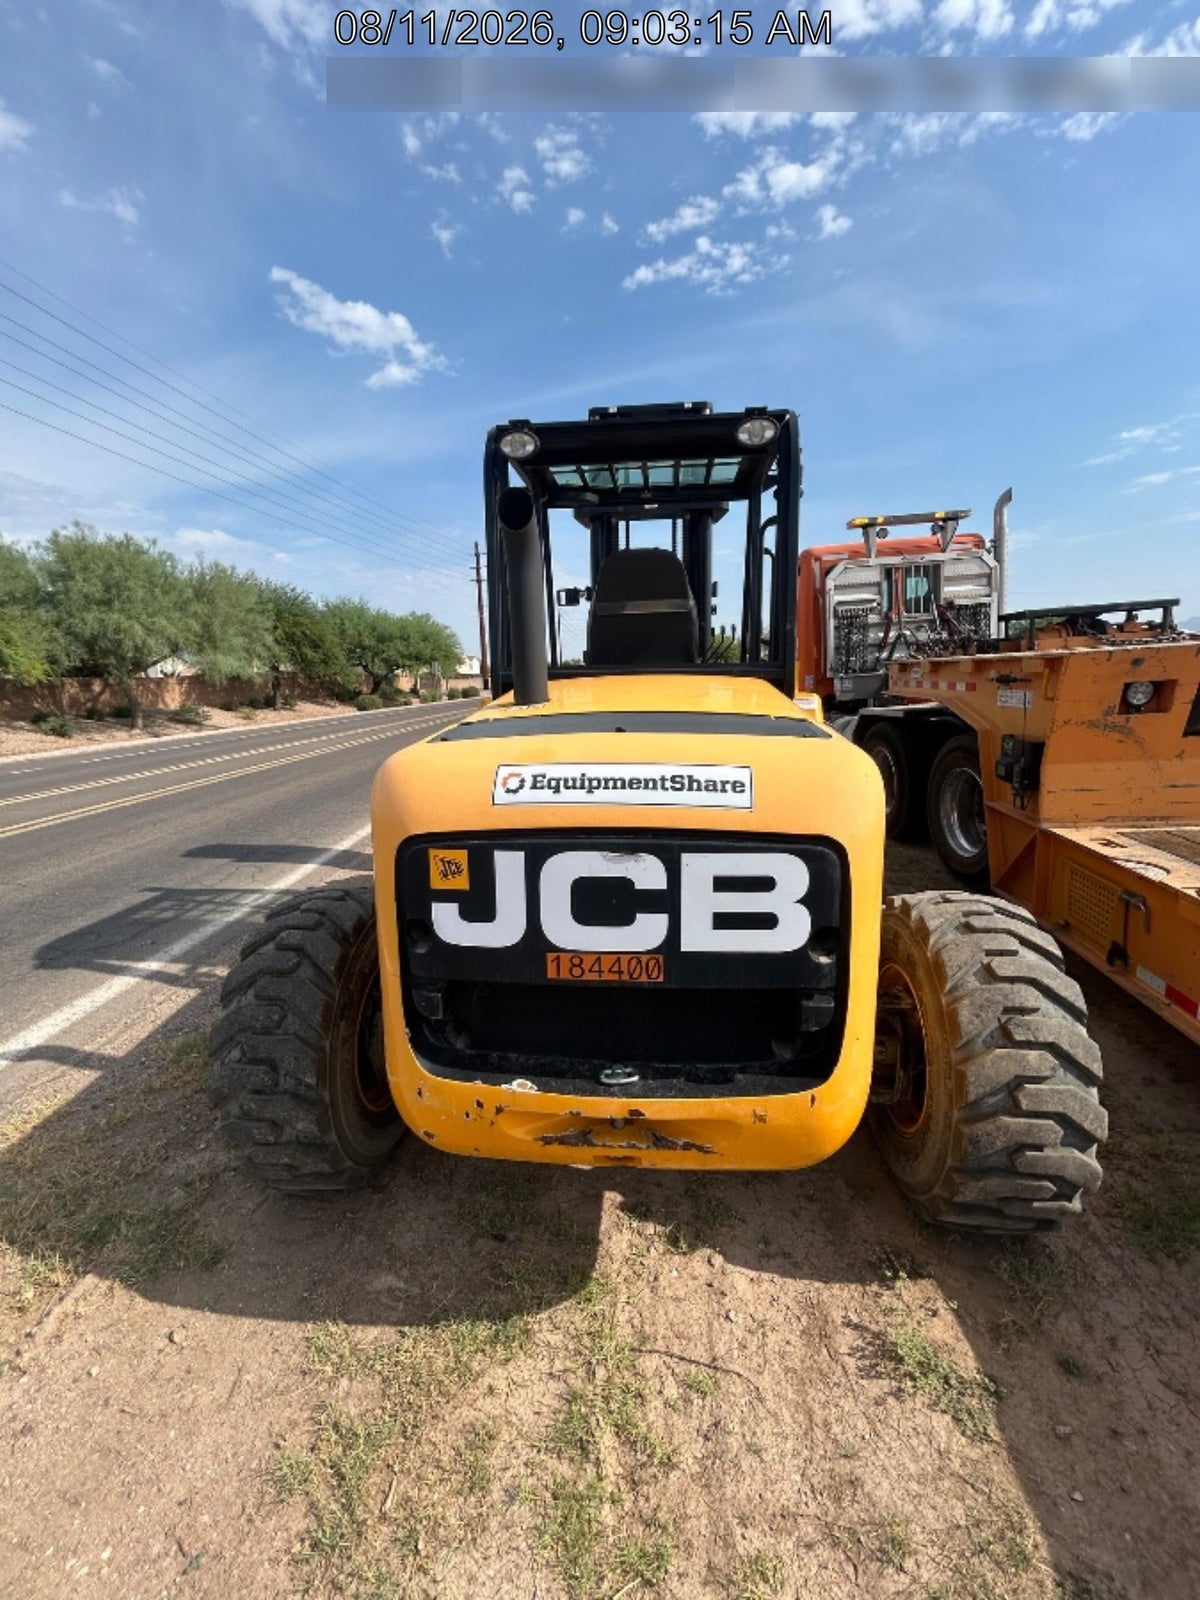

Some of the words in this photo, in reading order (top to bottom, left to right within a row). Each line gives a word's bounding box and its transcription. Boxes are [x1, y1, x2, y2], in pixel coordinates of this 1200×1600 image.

[529, 773, 746, 794] EquipmentShare
[431, 849, 812, 952] JCB
[550, 954, 662, 980] 184400
